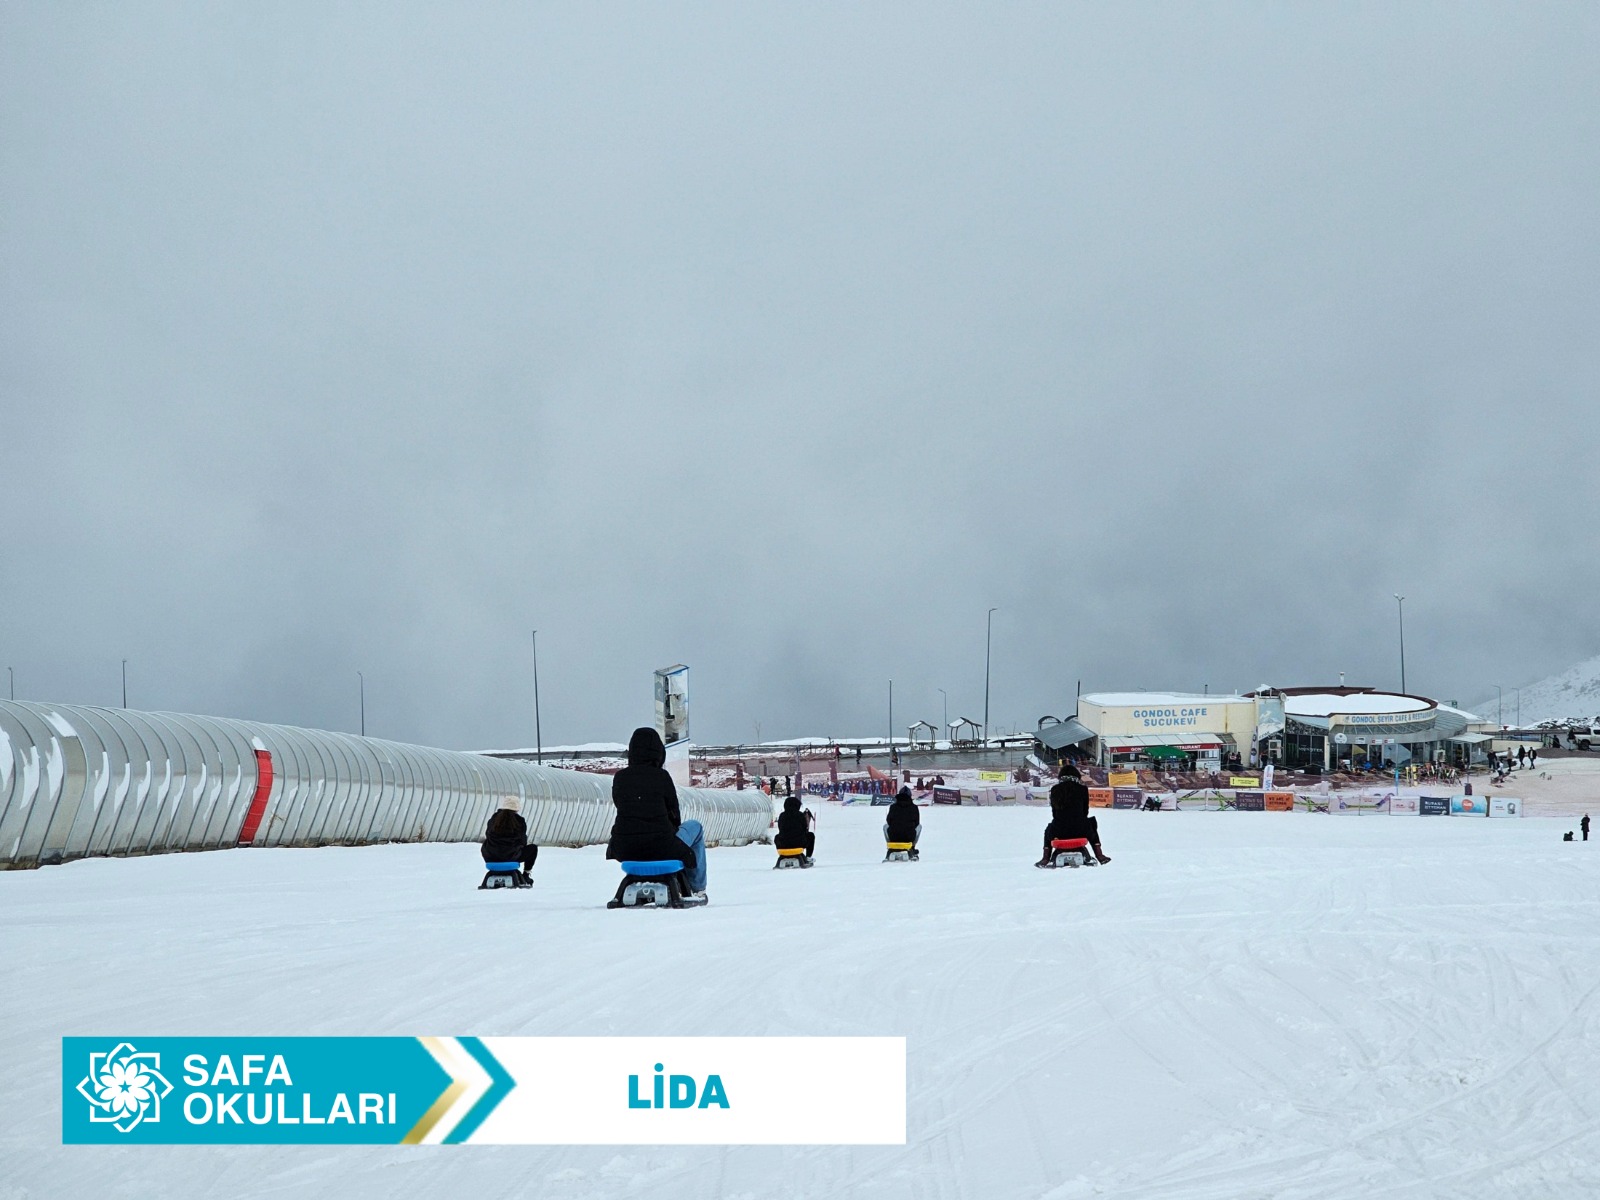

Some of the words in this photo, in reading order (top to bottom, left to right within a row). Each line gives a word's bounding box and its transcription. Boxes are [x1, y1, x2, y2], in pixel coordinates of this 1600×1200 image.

[1133, 709, 1177, 718] GONDOL
[1181, 708, 1207, 717] CAFE
[1395, 714, 1407, 722] CAFE
